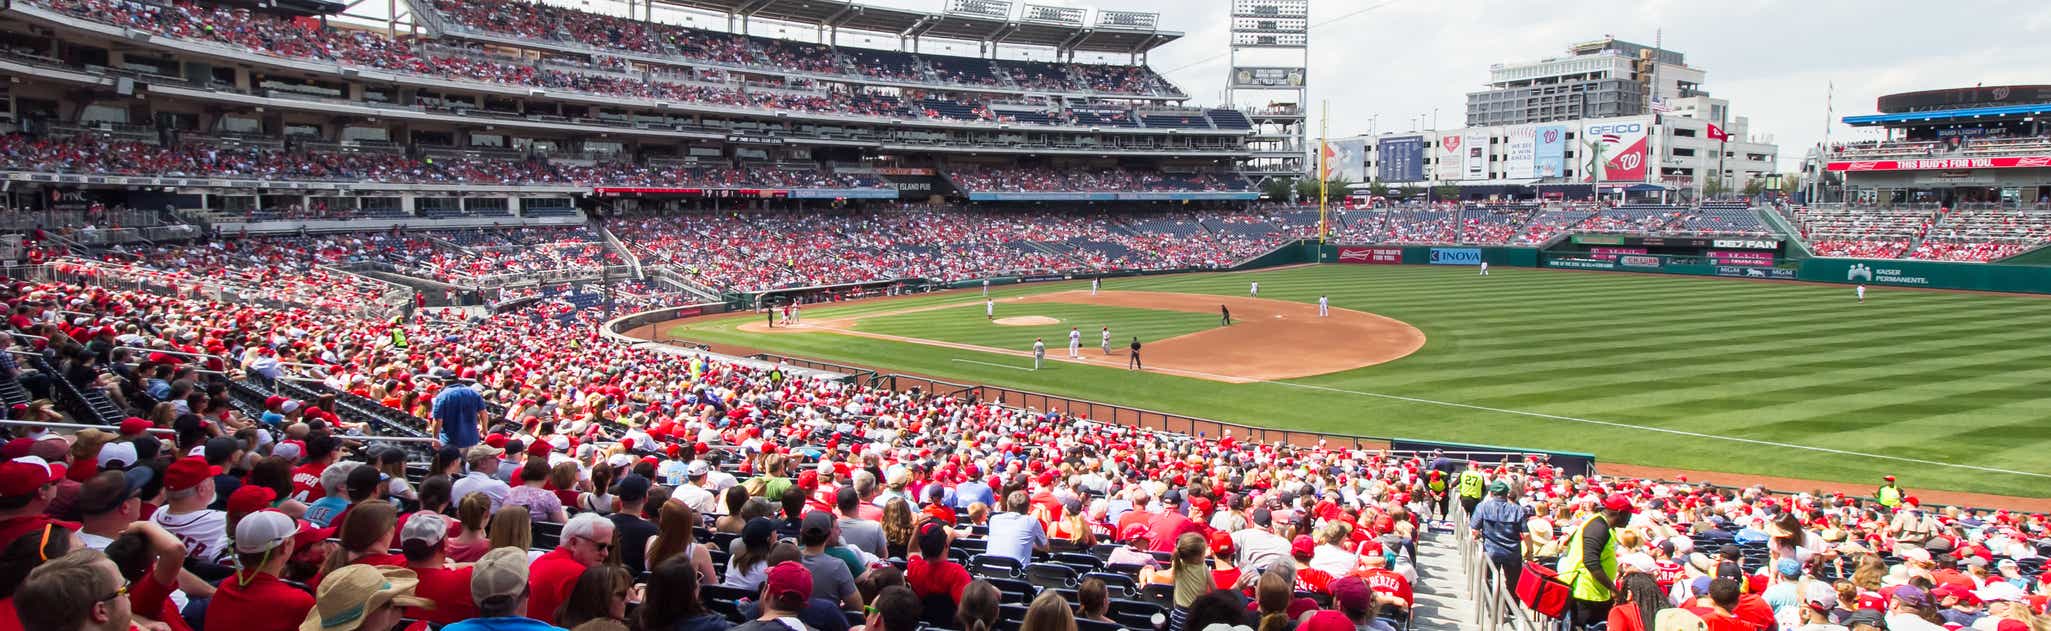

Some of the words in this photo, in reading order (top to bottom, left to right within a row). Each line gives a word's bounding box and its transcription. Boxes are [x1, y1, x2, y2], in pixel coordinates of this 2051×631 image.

[1590, 124, 1641, 135] GEICO
[1620, 151, 1641, 170] W
[1897, 160, 1918, 169] THIS
[1919, 159, 1949, 169] BUD'S
[1950, 159, 1969, 168] FOR
[1971, 158, 1994, 168] YOU.
[63, 191, 88, 201] PNC
[1746, 239, 1778, 249] FAN
[1442, 252, 1480, 262] INOVA
[1465, 474, 1479, 487] 27
